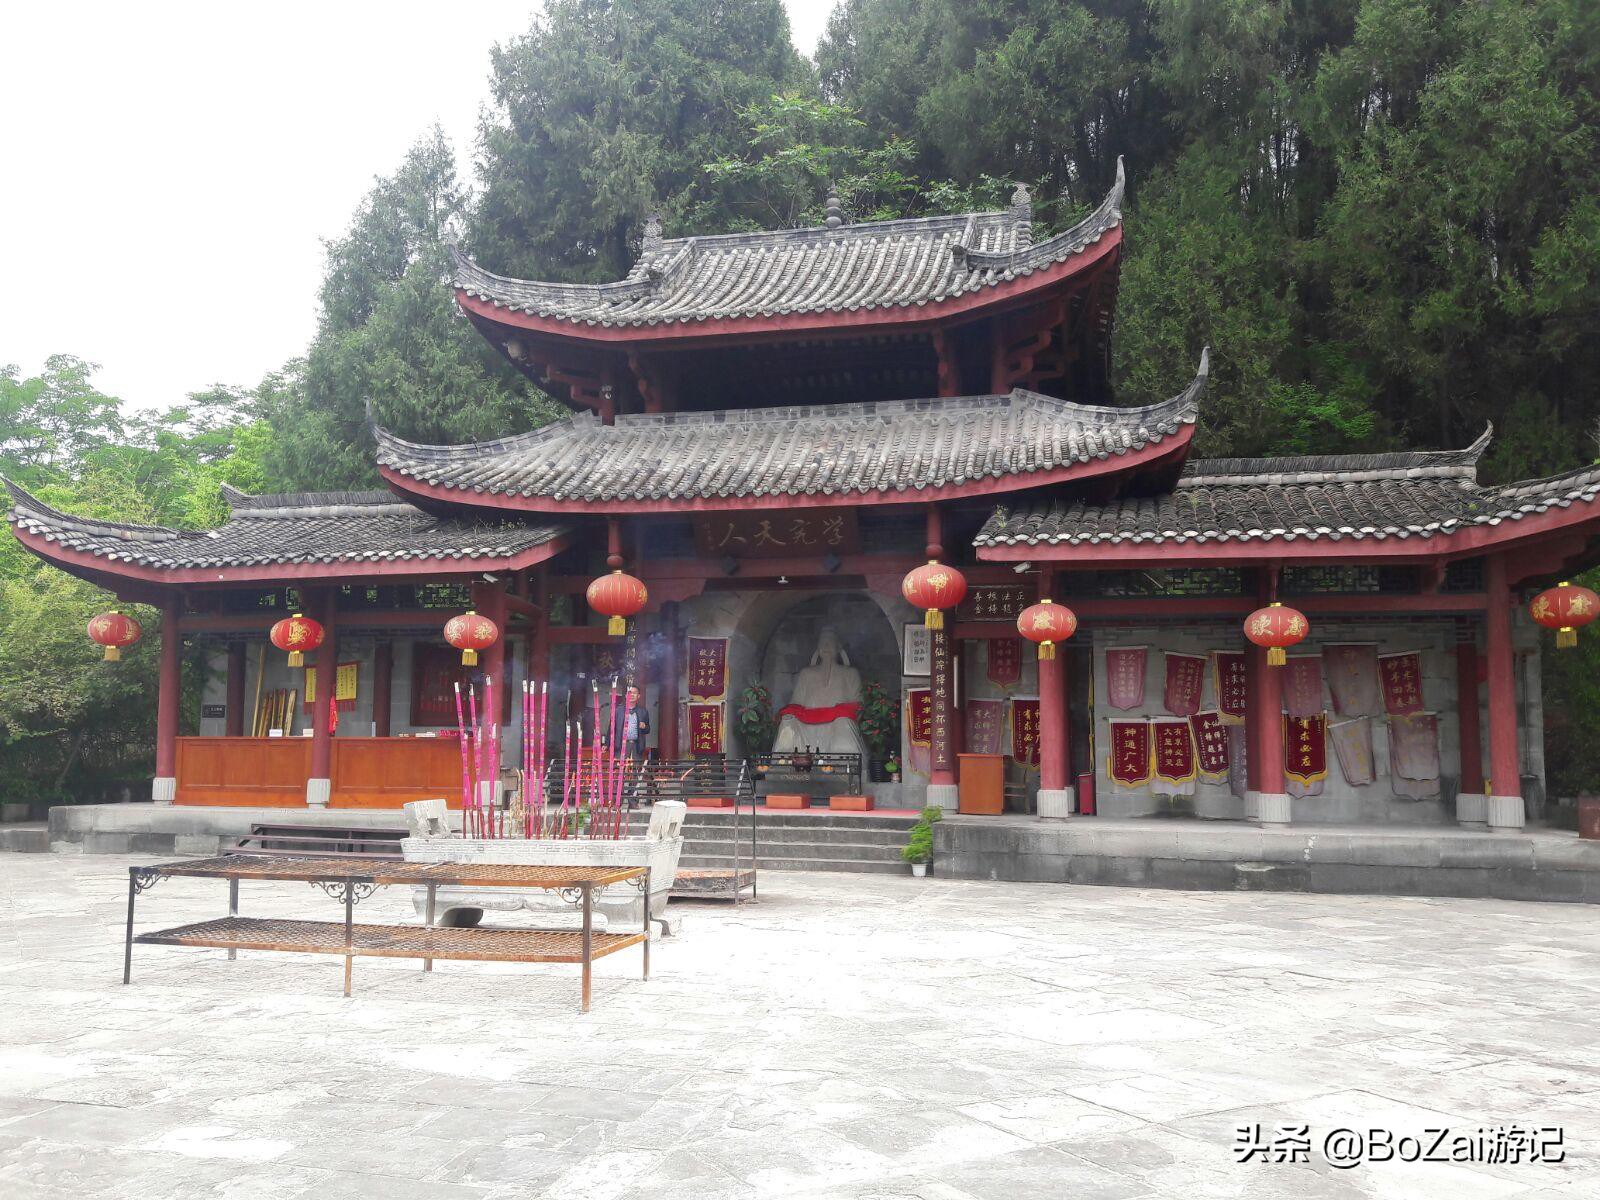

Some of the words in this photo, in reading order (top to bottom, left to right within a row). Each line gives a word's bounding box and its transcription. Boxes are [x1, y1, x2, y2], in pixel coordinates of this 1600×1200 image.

[700, 711, 712, 750] 有求必应
[1123, 727, 1138, 773] 神通广大
[1299, 718, 1312, 767] 有求必应
